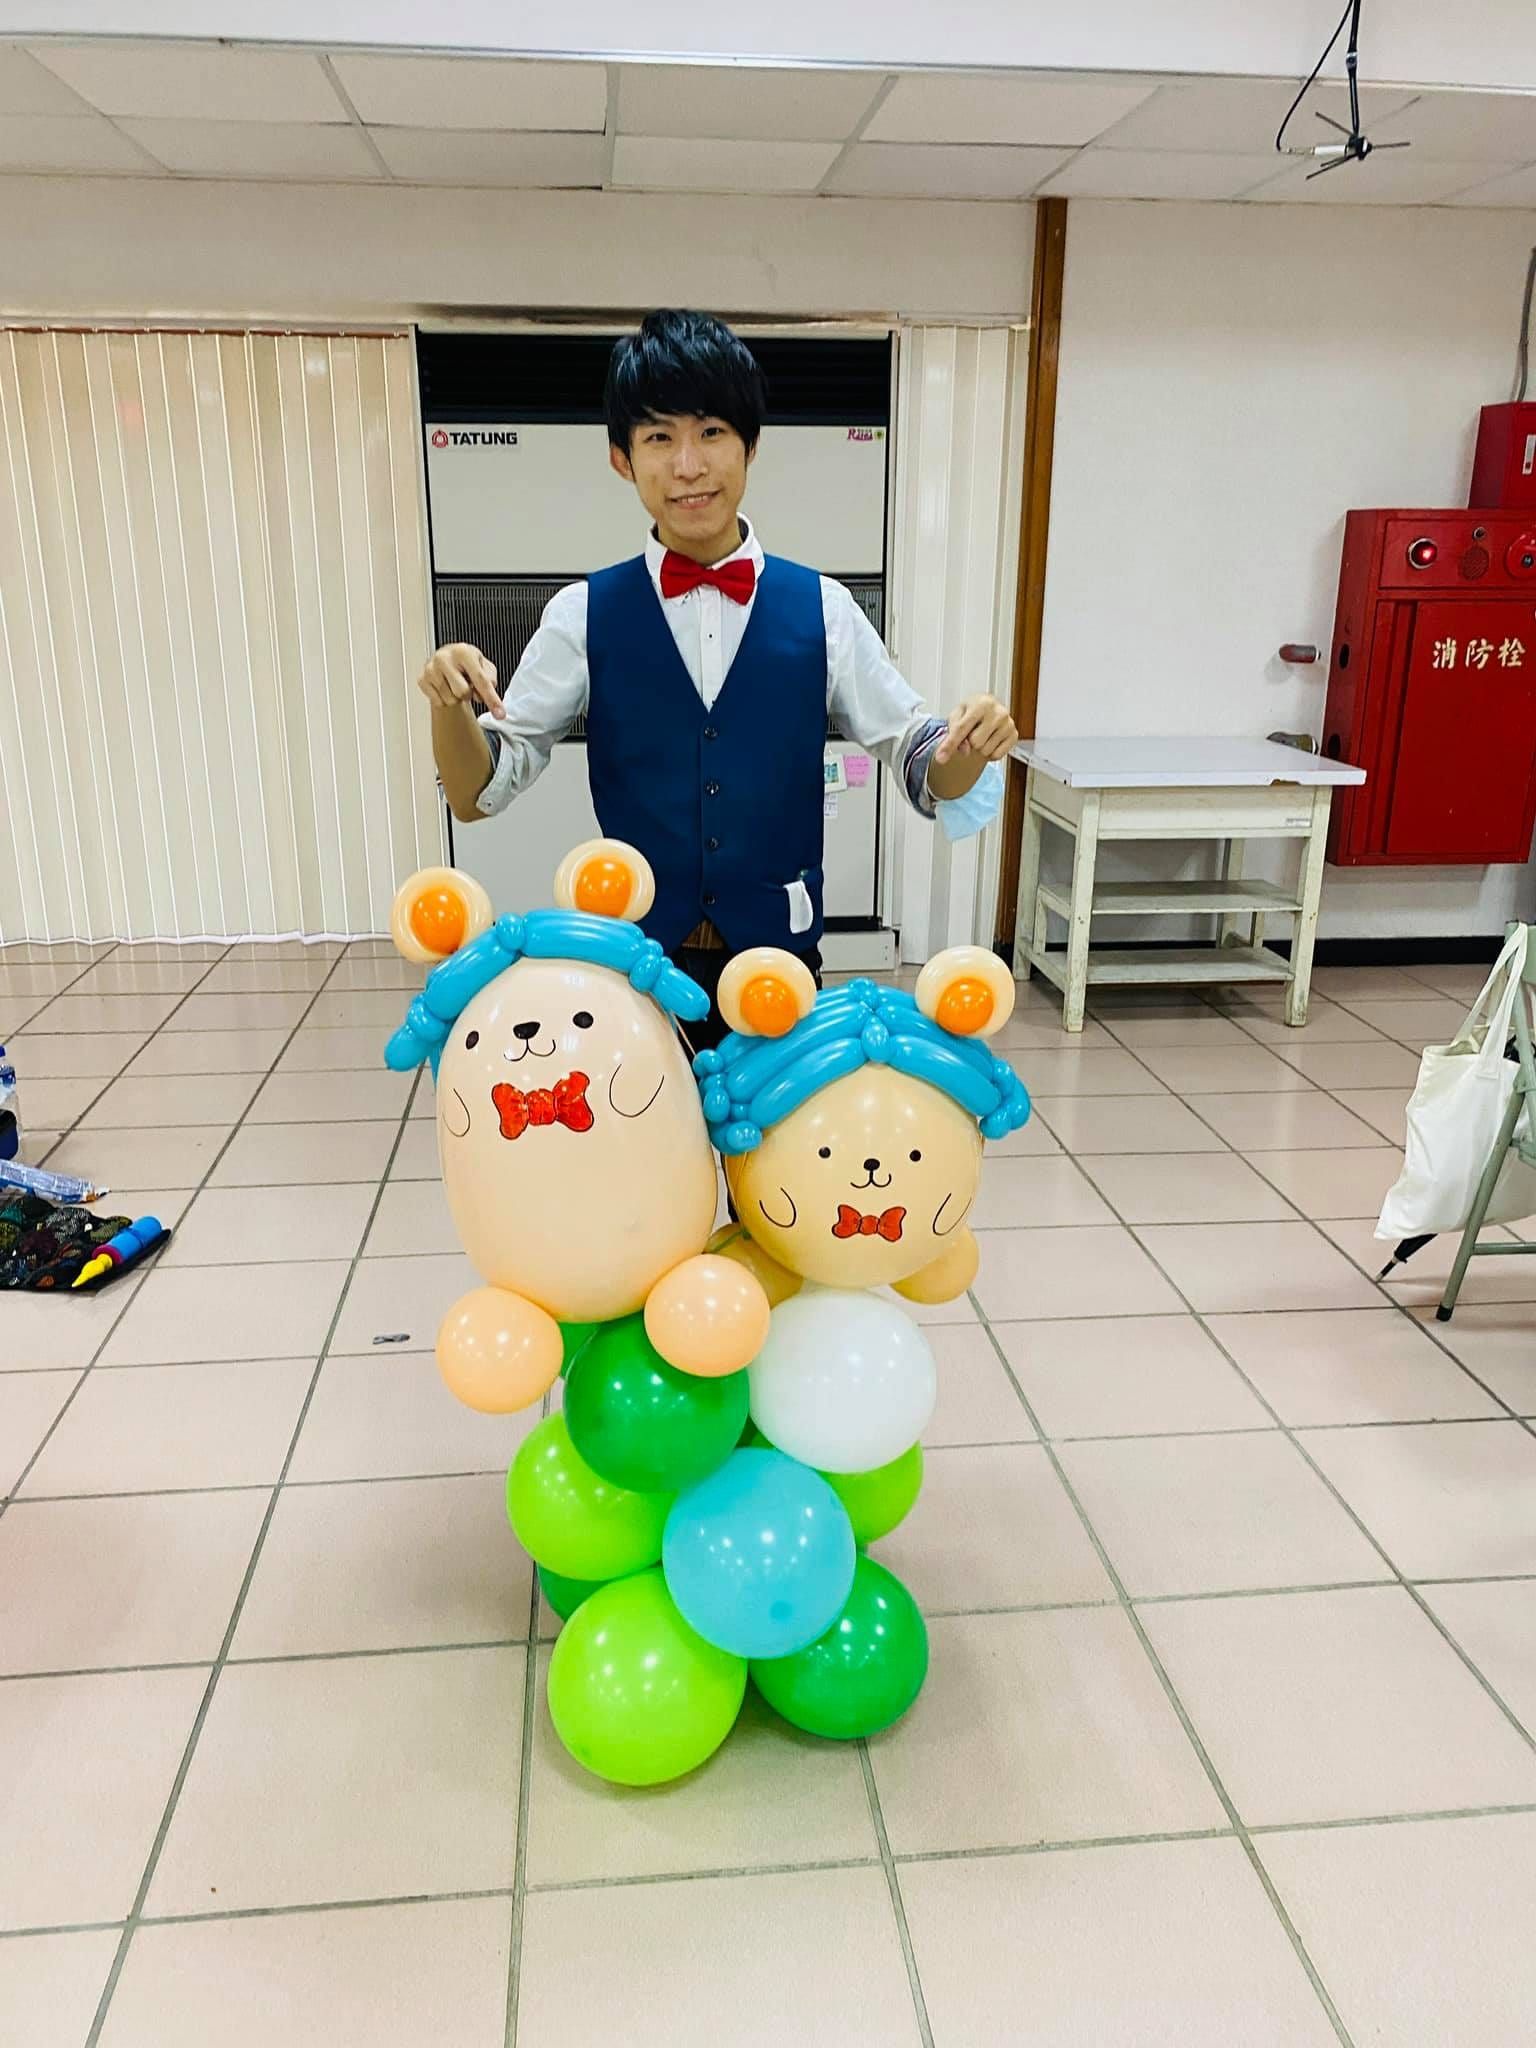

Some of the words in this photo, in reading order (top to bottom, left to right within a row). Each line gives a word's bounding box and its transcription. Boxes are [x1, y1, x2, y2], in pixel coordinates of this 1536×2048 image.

[449, 432, 518, 445] TATUNG
[1432, 637, 1526, 670] 消防栓
